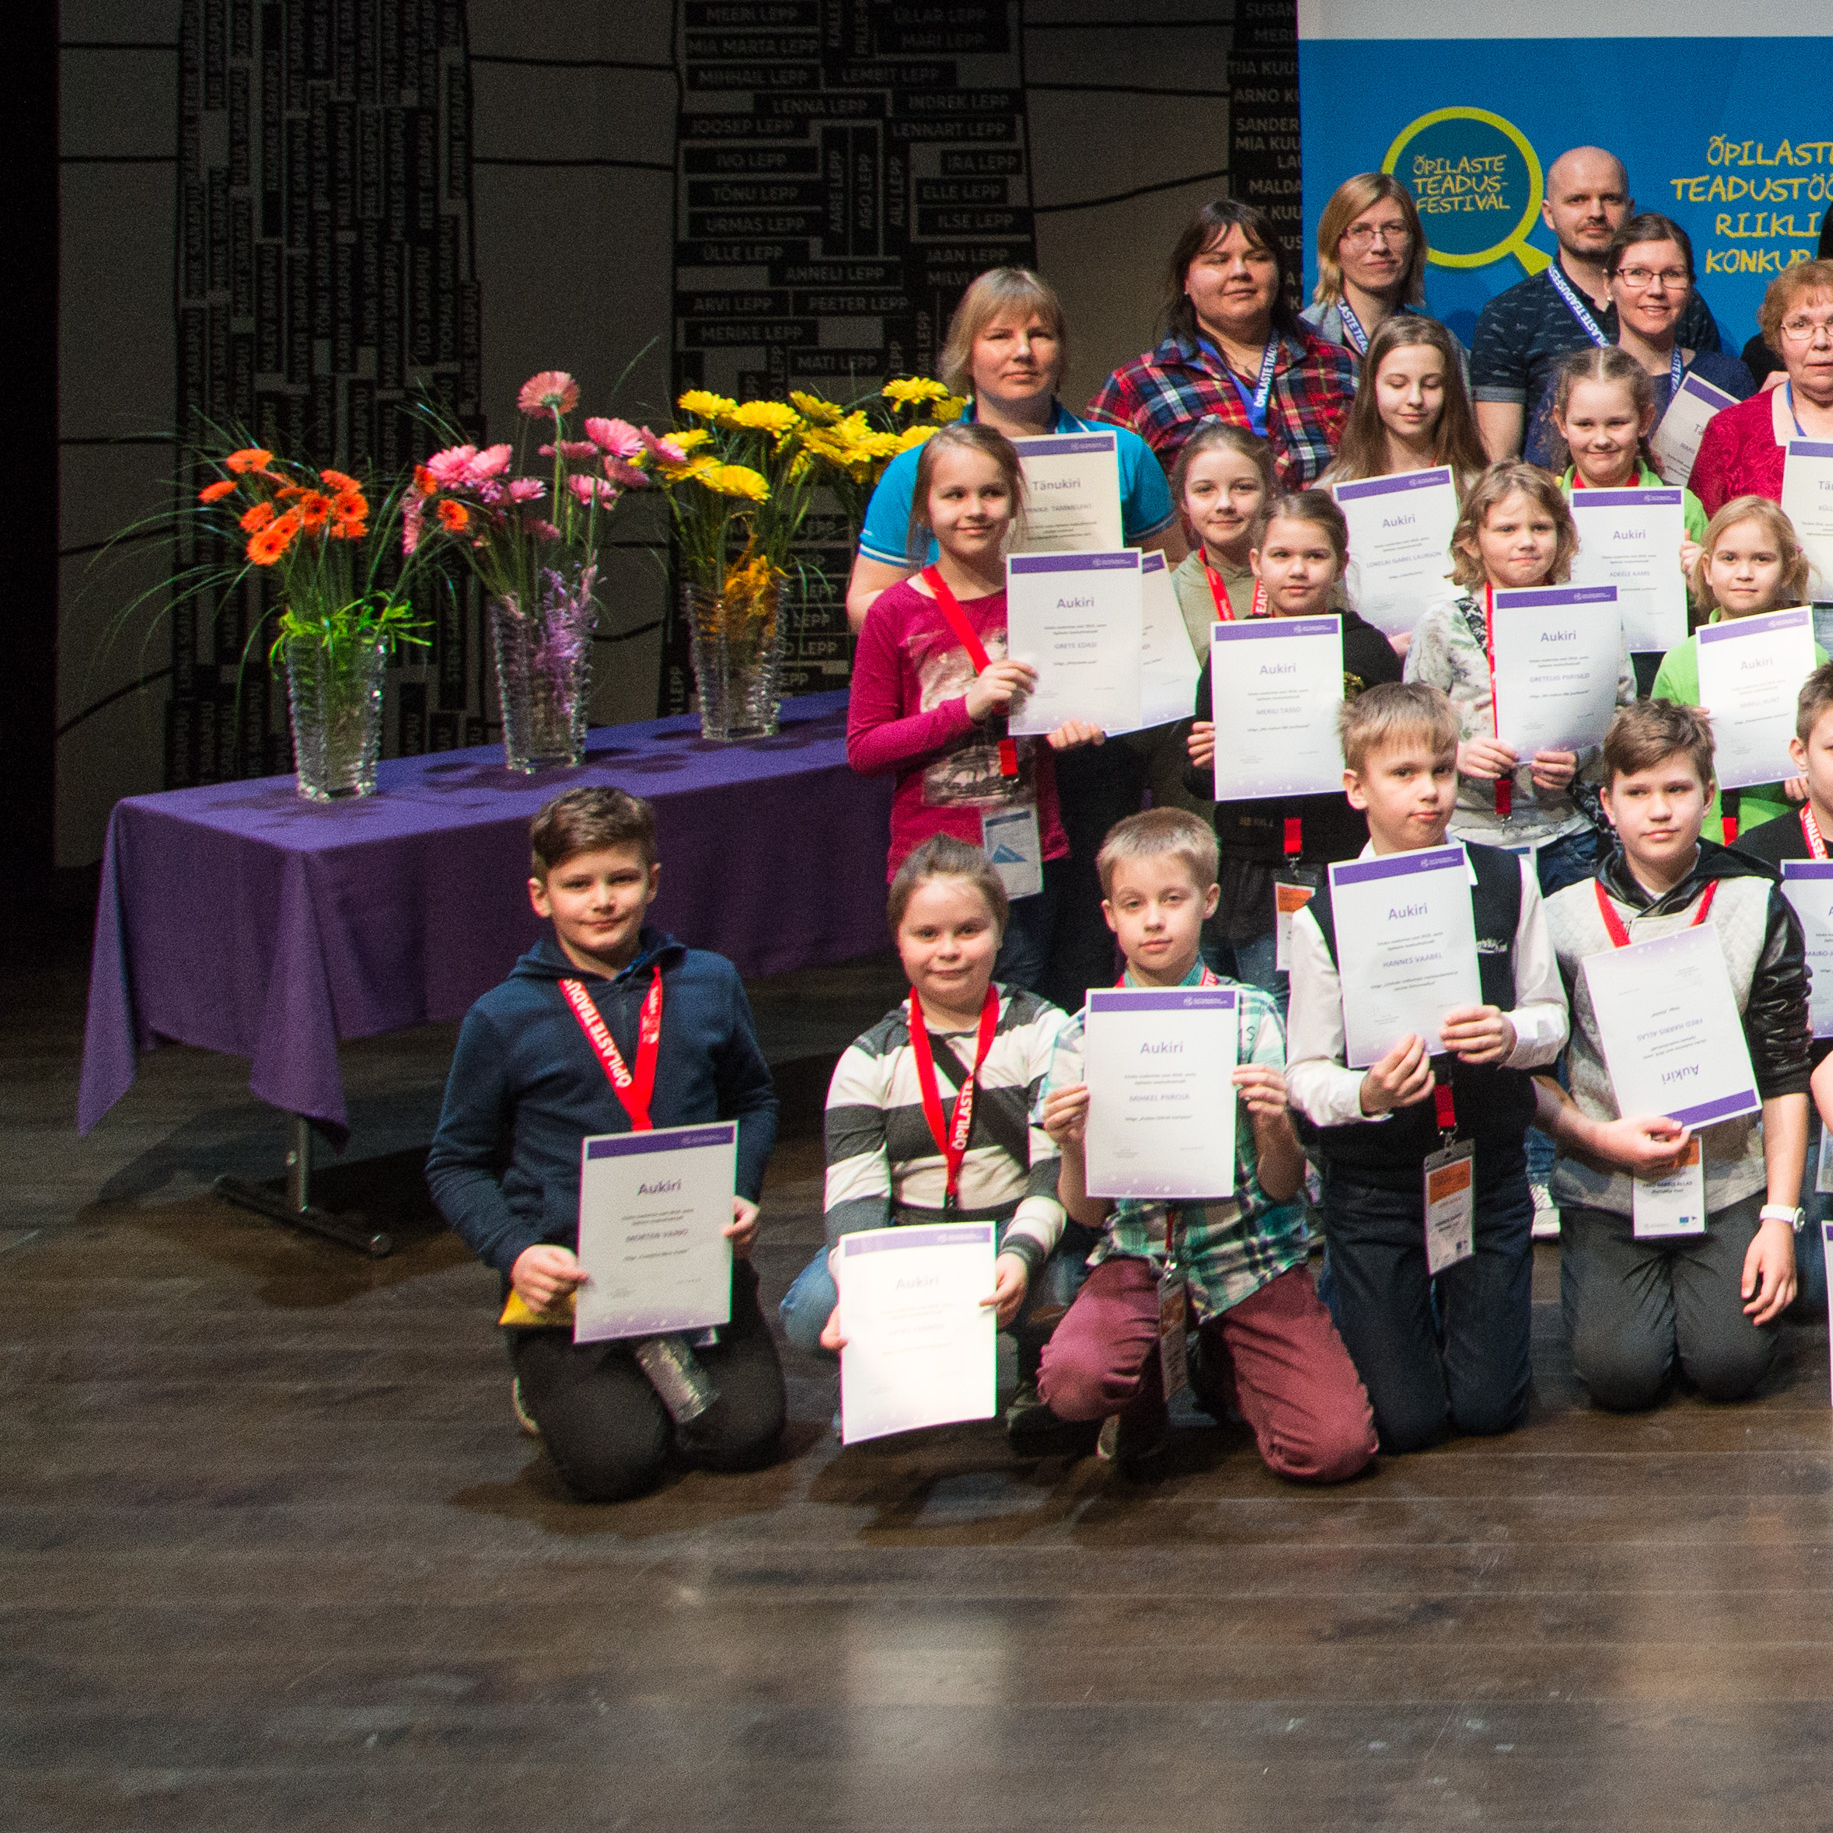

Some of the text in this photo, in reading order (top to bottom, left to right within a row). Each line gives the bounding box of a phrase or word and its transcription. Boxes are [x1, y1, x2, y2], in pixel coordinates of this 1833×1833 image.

[971, 94, 1009, 109] LEPP
[749, 153, 786, 167] LEPP
[1413, 154, 1507, 176] ÕPILASTE
[963, 185, 1001, 199] LEPP
[1412, 175, 1508, 198] TEADUS-
[761, 187, 798, 201] LEPP
[1416, 192, 1511, 213] FESTIVAL
[767, 217, 805, 232] LEPP
[1715, 211, 1821, 238] RIIKLI
[1033, 478, 1081, 493] Tänukiri
[1383, 516, 1415, 528] Aukiri
[1613, 530, 1646, 540] Aukiri
[1057, 598, 1094, 608] Aukiri
[1541, 631, 1576, 642] Aukiri
[1260, 663, 1296, 675] Aukiri
[1741, 659, 1773, 670] Aukiri
[1388, 903, 1427, 920] Aukiri
[1140, 1042, 1183, 1054] Aukiri
[588, 1023, 633, 1089] ÕPILASTE
[1662, 1064, 1699, 1084] Aukiri
[637, 1180, 681, 1195] Aukiri
[896, 1277, 939, 1289] Aukiri
